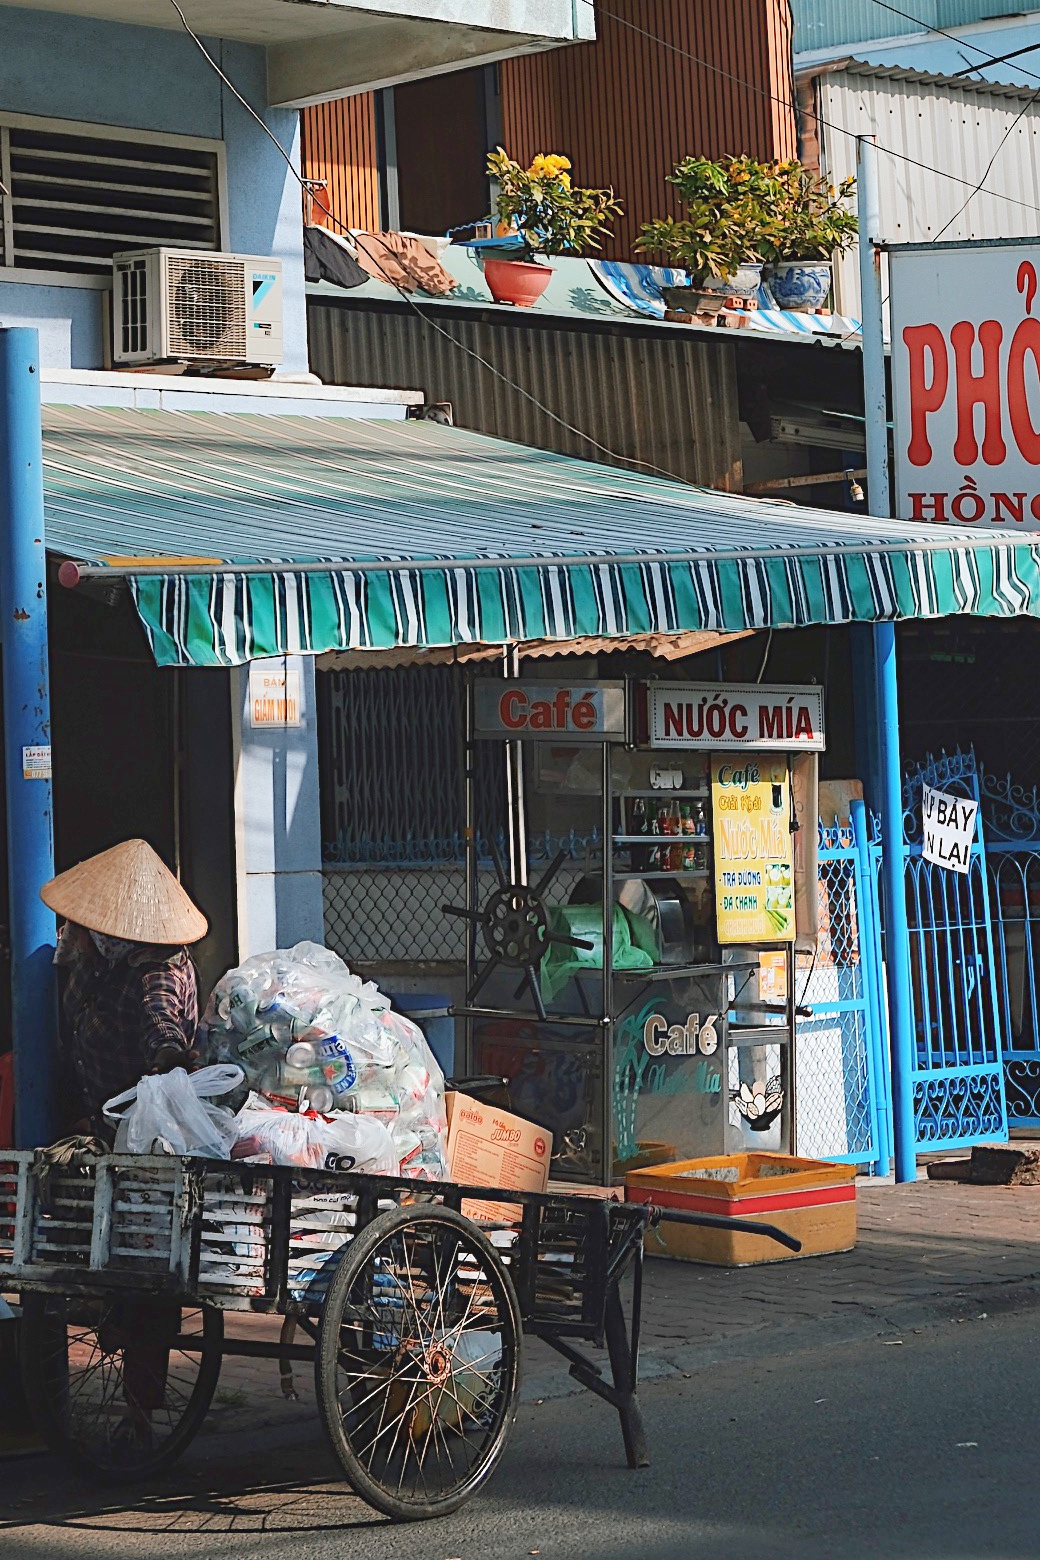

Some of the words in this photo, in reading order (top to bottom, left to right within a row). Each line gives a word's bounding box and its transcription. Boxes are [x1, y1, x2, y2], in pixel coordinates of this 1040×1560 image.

[499, 689, 598, 731] Café
[663, 693, 749, 739] NƯỚC
[759, 696, 815, 740] MÍA
[717, 761, 761, 792] Café
[937, 797, 974, 832] BẢY
[719, 816, 758, 860] Nước
[759, 815, 787, 860] Mía
[938, 837, 970, 868] LẠI
[735, 895, 758, 911] CHANH
[644, 1013, 718, 1056] Café
[491, 1128, 521, 1142] JUMBO
